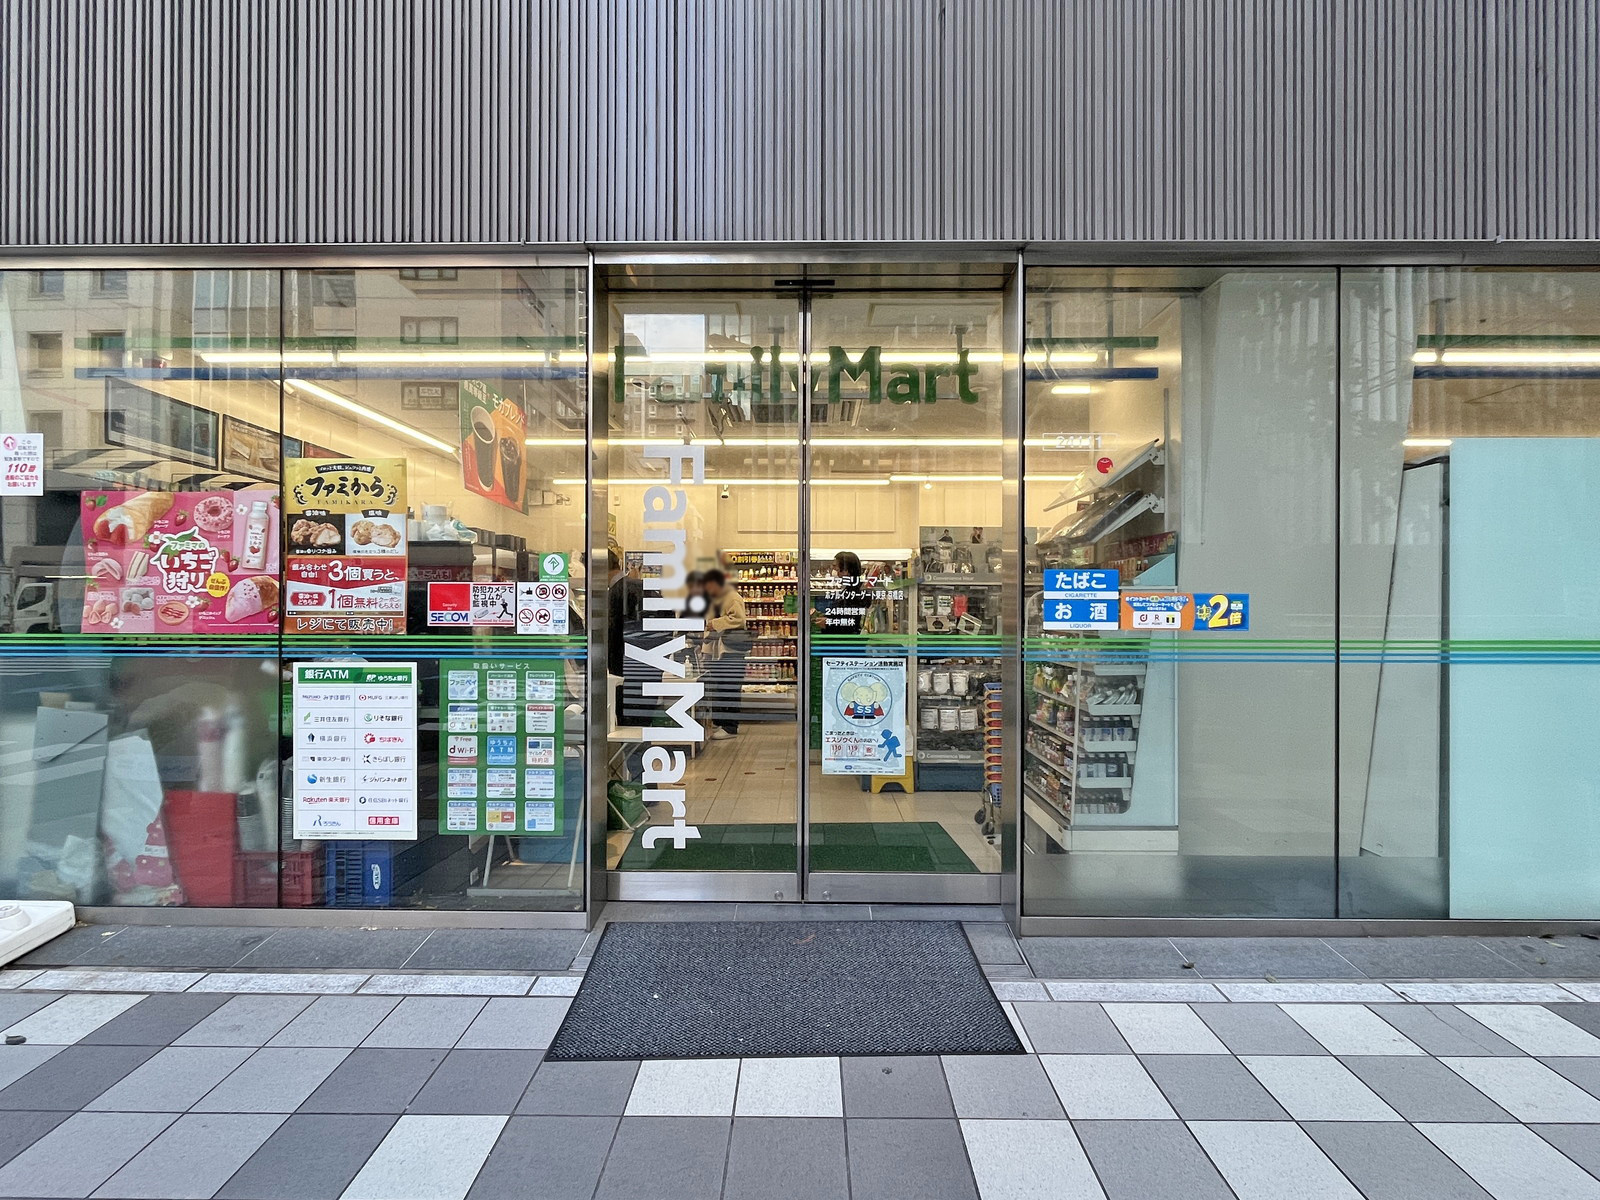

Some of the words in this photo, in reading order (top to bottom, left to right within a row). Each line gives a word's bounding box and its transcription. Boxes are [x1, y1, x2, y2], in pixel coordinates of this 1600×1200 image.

[8, 463, 37, 473] 110番
[305, 476, 384, 497] ファミから
[169, 540, 207, 551] ファミマの
[161, 551, 217, 571] いちご
[168, 571, 206, 592] 狩り
[826, 576, 894, 587] ファミリーマート
[1056, 572, 1107, 590] たばこ
[472, 586, 514, 594] 防犯カメラで
[328, 588, 378, 609] 1個無料
[430, 612, 468, 622] SECOM
[824, 608, 866, 616] 24時間営業
[296, 618, 394, 630] レジにて販売中!
[825, 618, 856, 626] 年中無休
[624, 445, 704, 850] FamilyMart
[304, 670, 349, 680] 銀行ATM
[369, 817, 399, 825] 信用金庫
